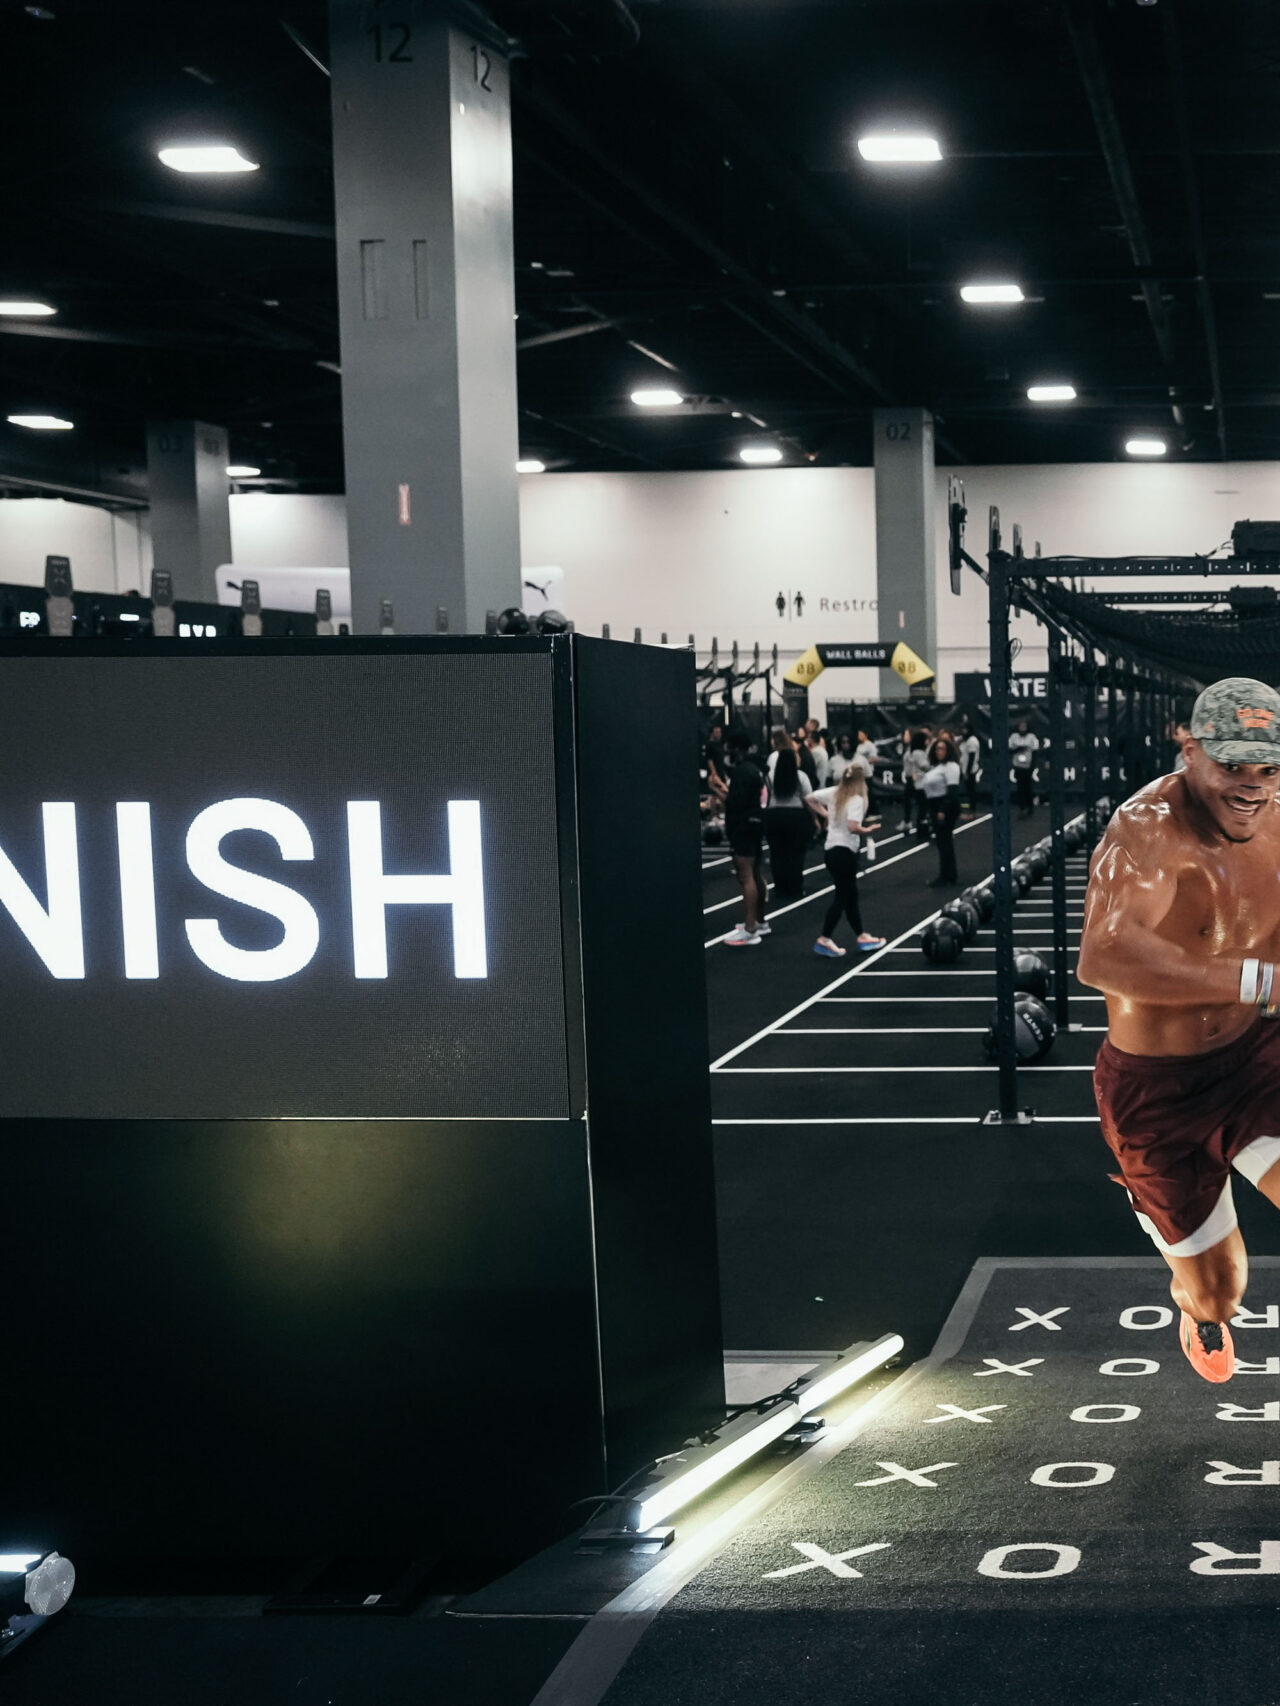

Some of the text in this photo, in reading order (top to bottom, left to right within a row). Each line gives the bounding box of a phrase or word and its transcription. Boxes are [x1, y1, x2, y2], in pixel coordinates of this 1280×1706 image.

[367, 23, 413, 63] 12
[471, 45, 492, 93] 12
[886, 421, 911, 441] 02
[826, 649, 886, 660] WALL BALLS
[796, 662, 816, 675] 08
[897, 661, 917, 675] 08
[0, 797, 488, 982] NISH
